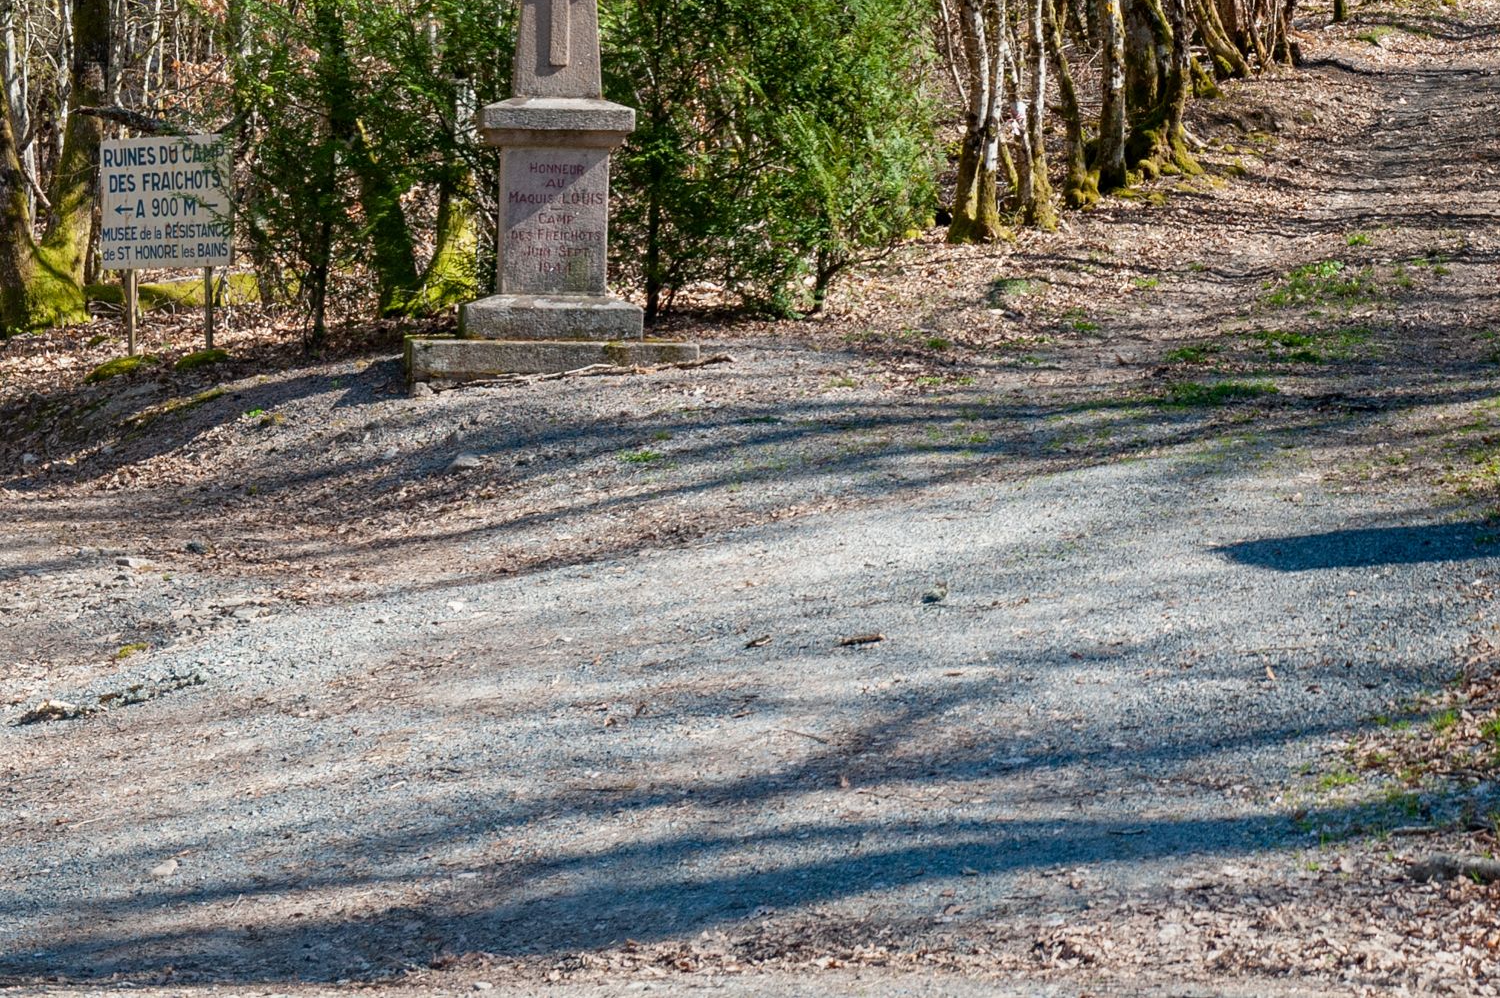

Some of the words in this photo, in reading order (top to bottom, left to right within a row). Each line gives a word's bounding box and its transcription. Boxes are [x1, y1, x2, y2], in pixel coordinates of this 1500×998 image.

[103, 146, 156, 168] RUINES
[159, 145, 178, 164] DU
[182, 143, 225, 163] CAMP
[529, 162, 585, 175] HONNEUR
[109, 174, 136, 193] DES
[142, 169, 221, 191] FRAICHOTS
[545, 179, 565, 188] AU
[508, 191, 554, 204] MAQUIS
[562, 192, 604, 205] LOUIS
[151, 197, 179, 217] 900
[183, 198, 197, 216] M
[538, 212, 575, 225] CAMP
[140, 227, 152, 240] de
[154, 226, 162, 239] la
[511, 230, 533, 242] DES
[103, 250, 116, 261] de
[117, 246, 132, 261] ST
[135, 244, 178, 260] HONORE
[181, 245, 196, 258] les
[197, 242, 229, 258] BAINS
